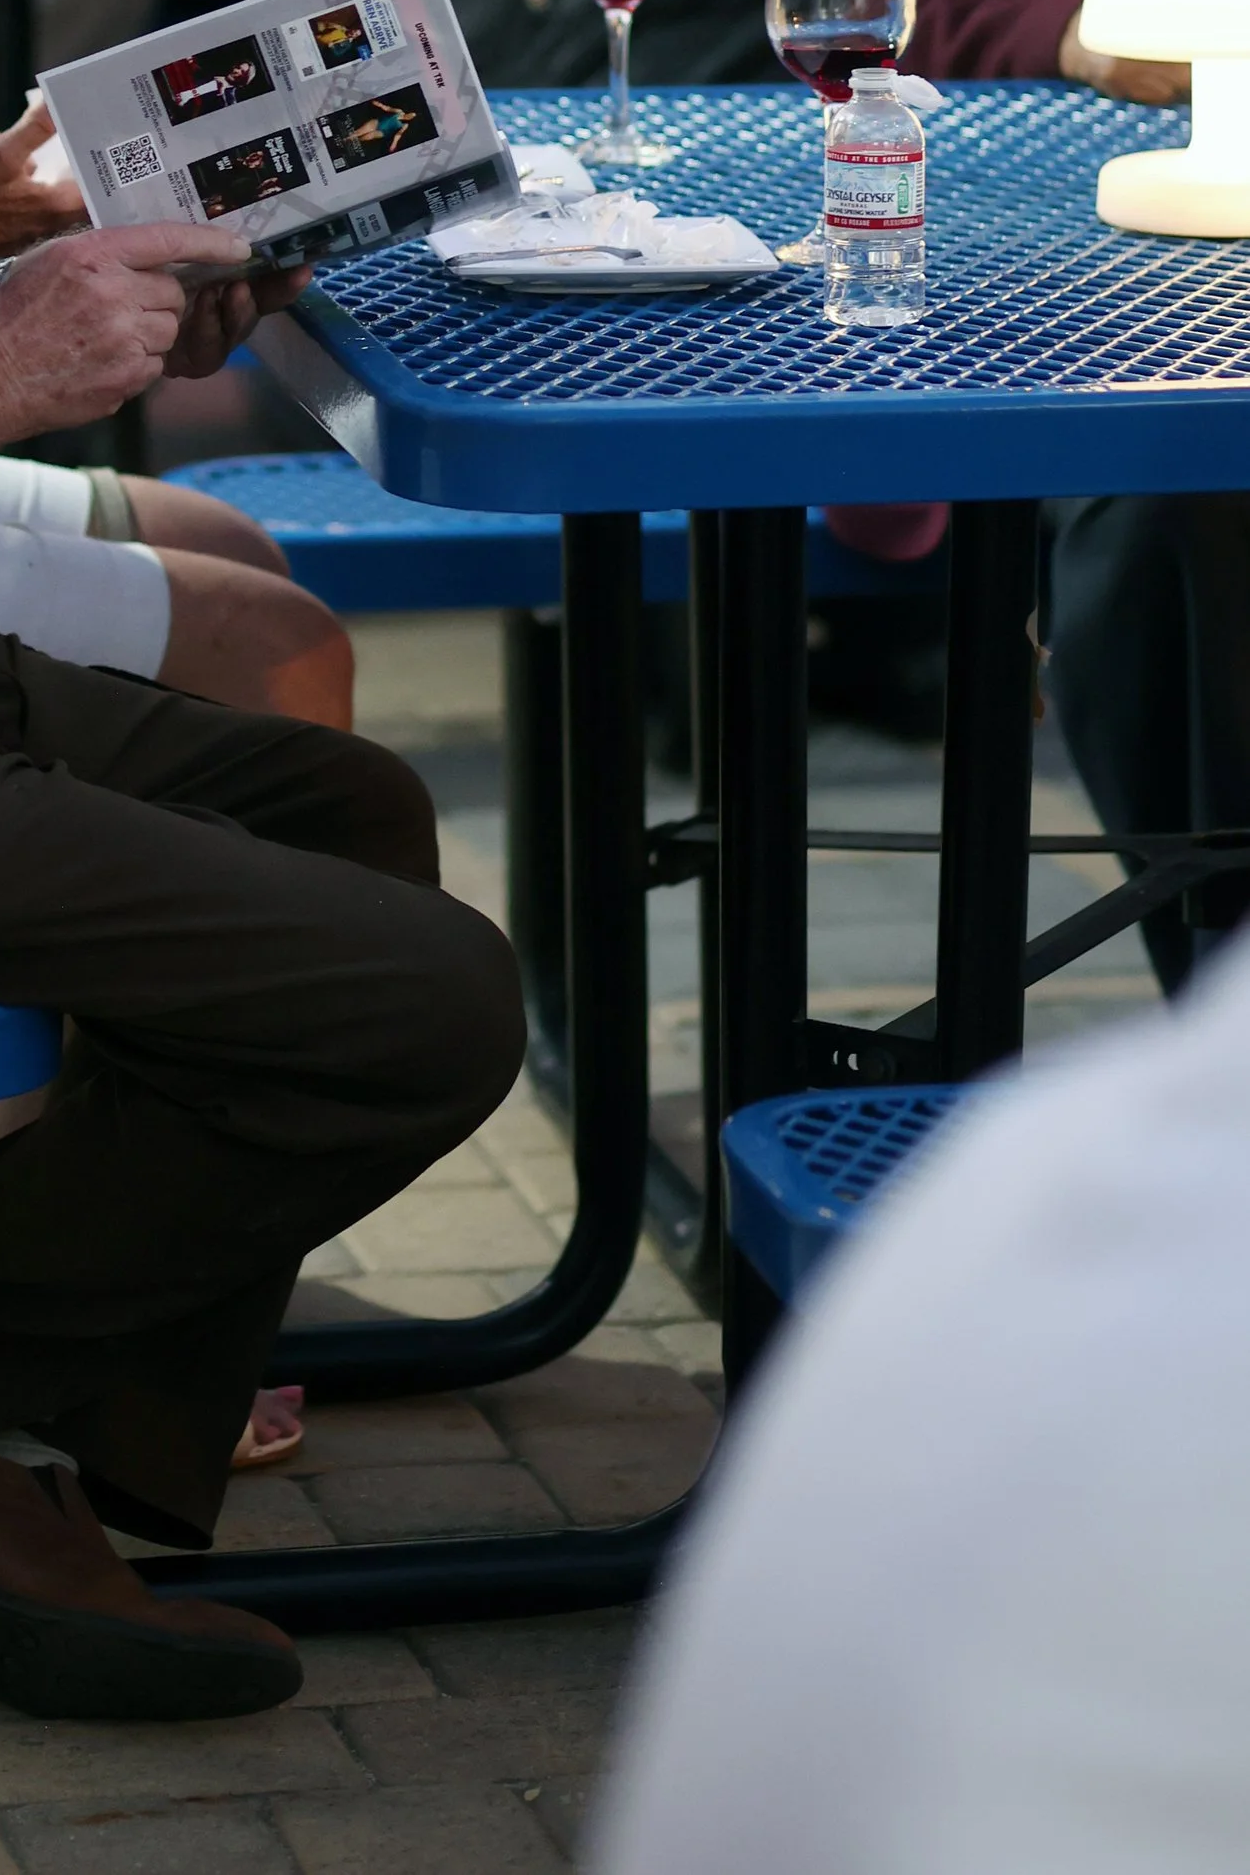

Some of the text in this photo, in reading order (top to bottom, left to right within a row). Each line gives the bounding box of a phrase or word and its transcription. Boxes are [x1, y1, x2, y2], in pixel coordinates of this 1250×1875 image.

[413, 22, 445, 88] UPCOMING AT TRK
[882, 155, 909, 163] SOURCE
[855, 192, 895, 203] GEYSER
